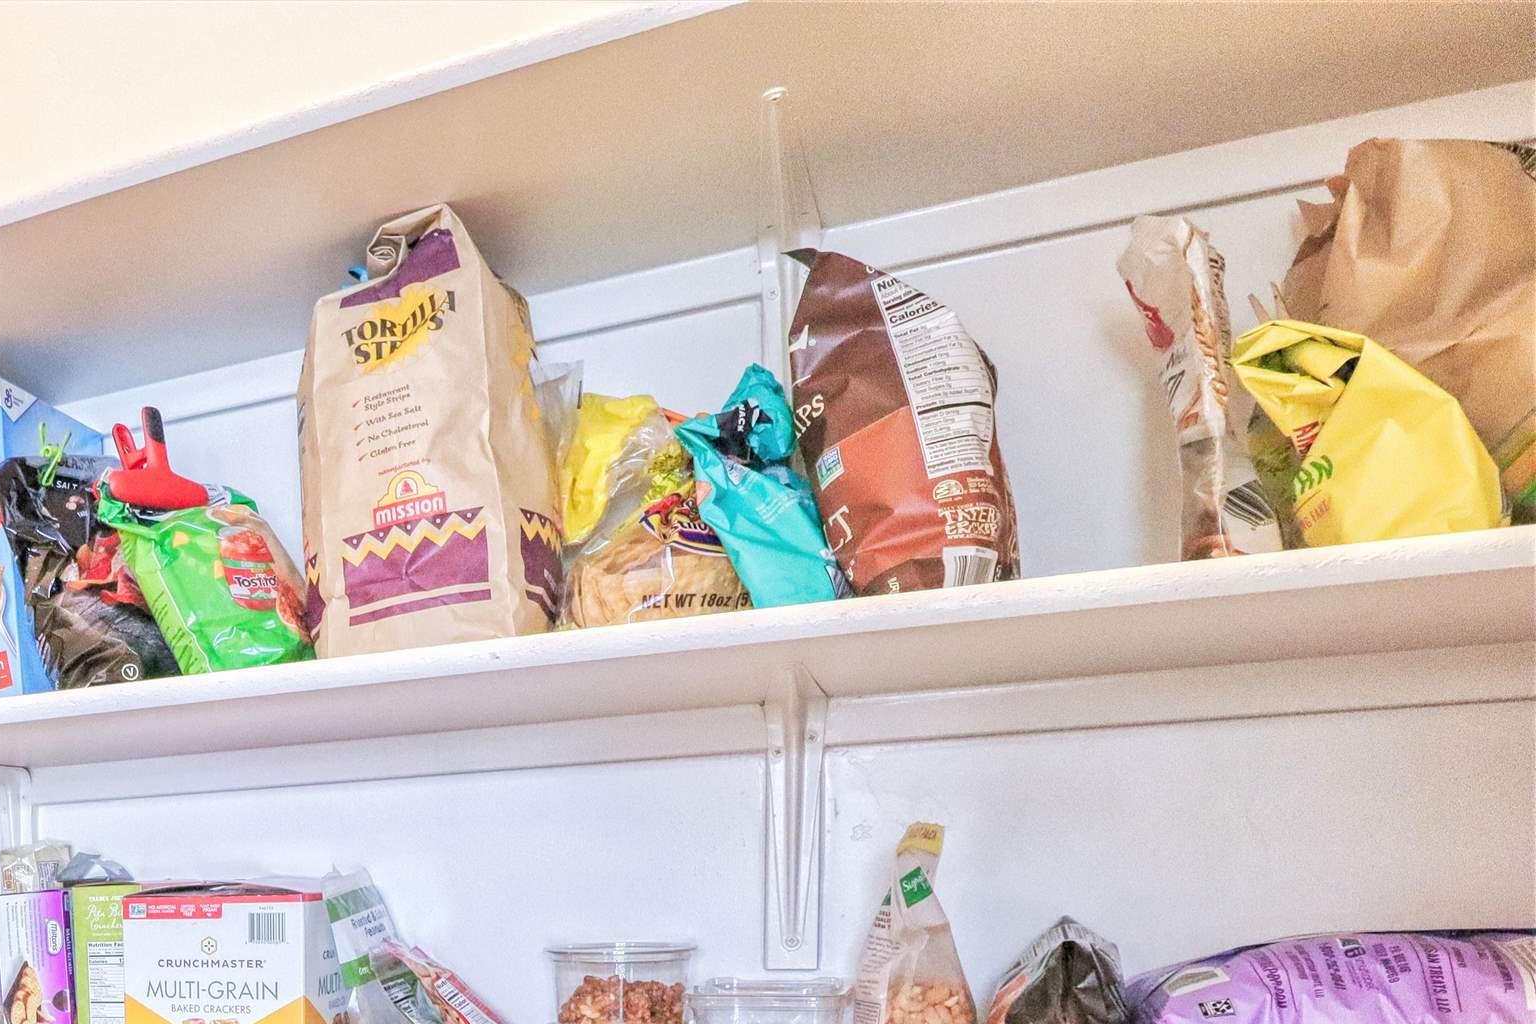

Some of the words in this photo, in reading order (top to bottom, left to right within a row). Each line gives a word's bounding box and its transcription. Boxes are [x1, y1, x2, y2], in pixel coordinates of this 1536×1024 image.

[341, 290, 456, 347] TORTILLA
[889, 300, 939, 324] Calories
[367, 433, 380, 444] No
[381, 419, 429, 439] Cholesterol
[370, 445, 397, 459] Gluten
[642, 593, 673, 609] NET
[674, 593, 696, 608] WT
[700, 592, 732, 608] 18oz
[158, 959, 265, 969] CRUNCHMASTER
[145, 980, 279, 1001] MULTI-GRAIN
[1431, 965, 1447, 996] TREATS
[171, 1003, 199, 1014] BAKED
[201, 1003, 252, 1015] CRACKERS
